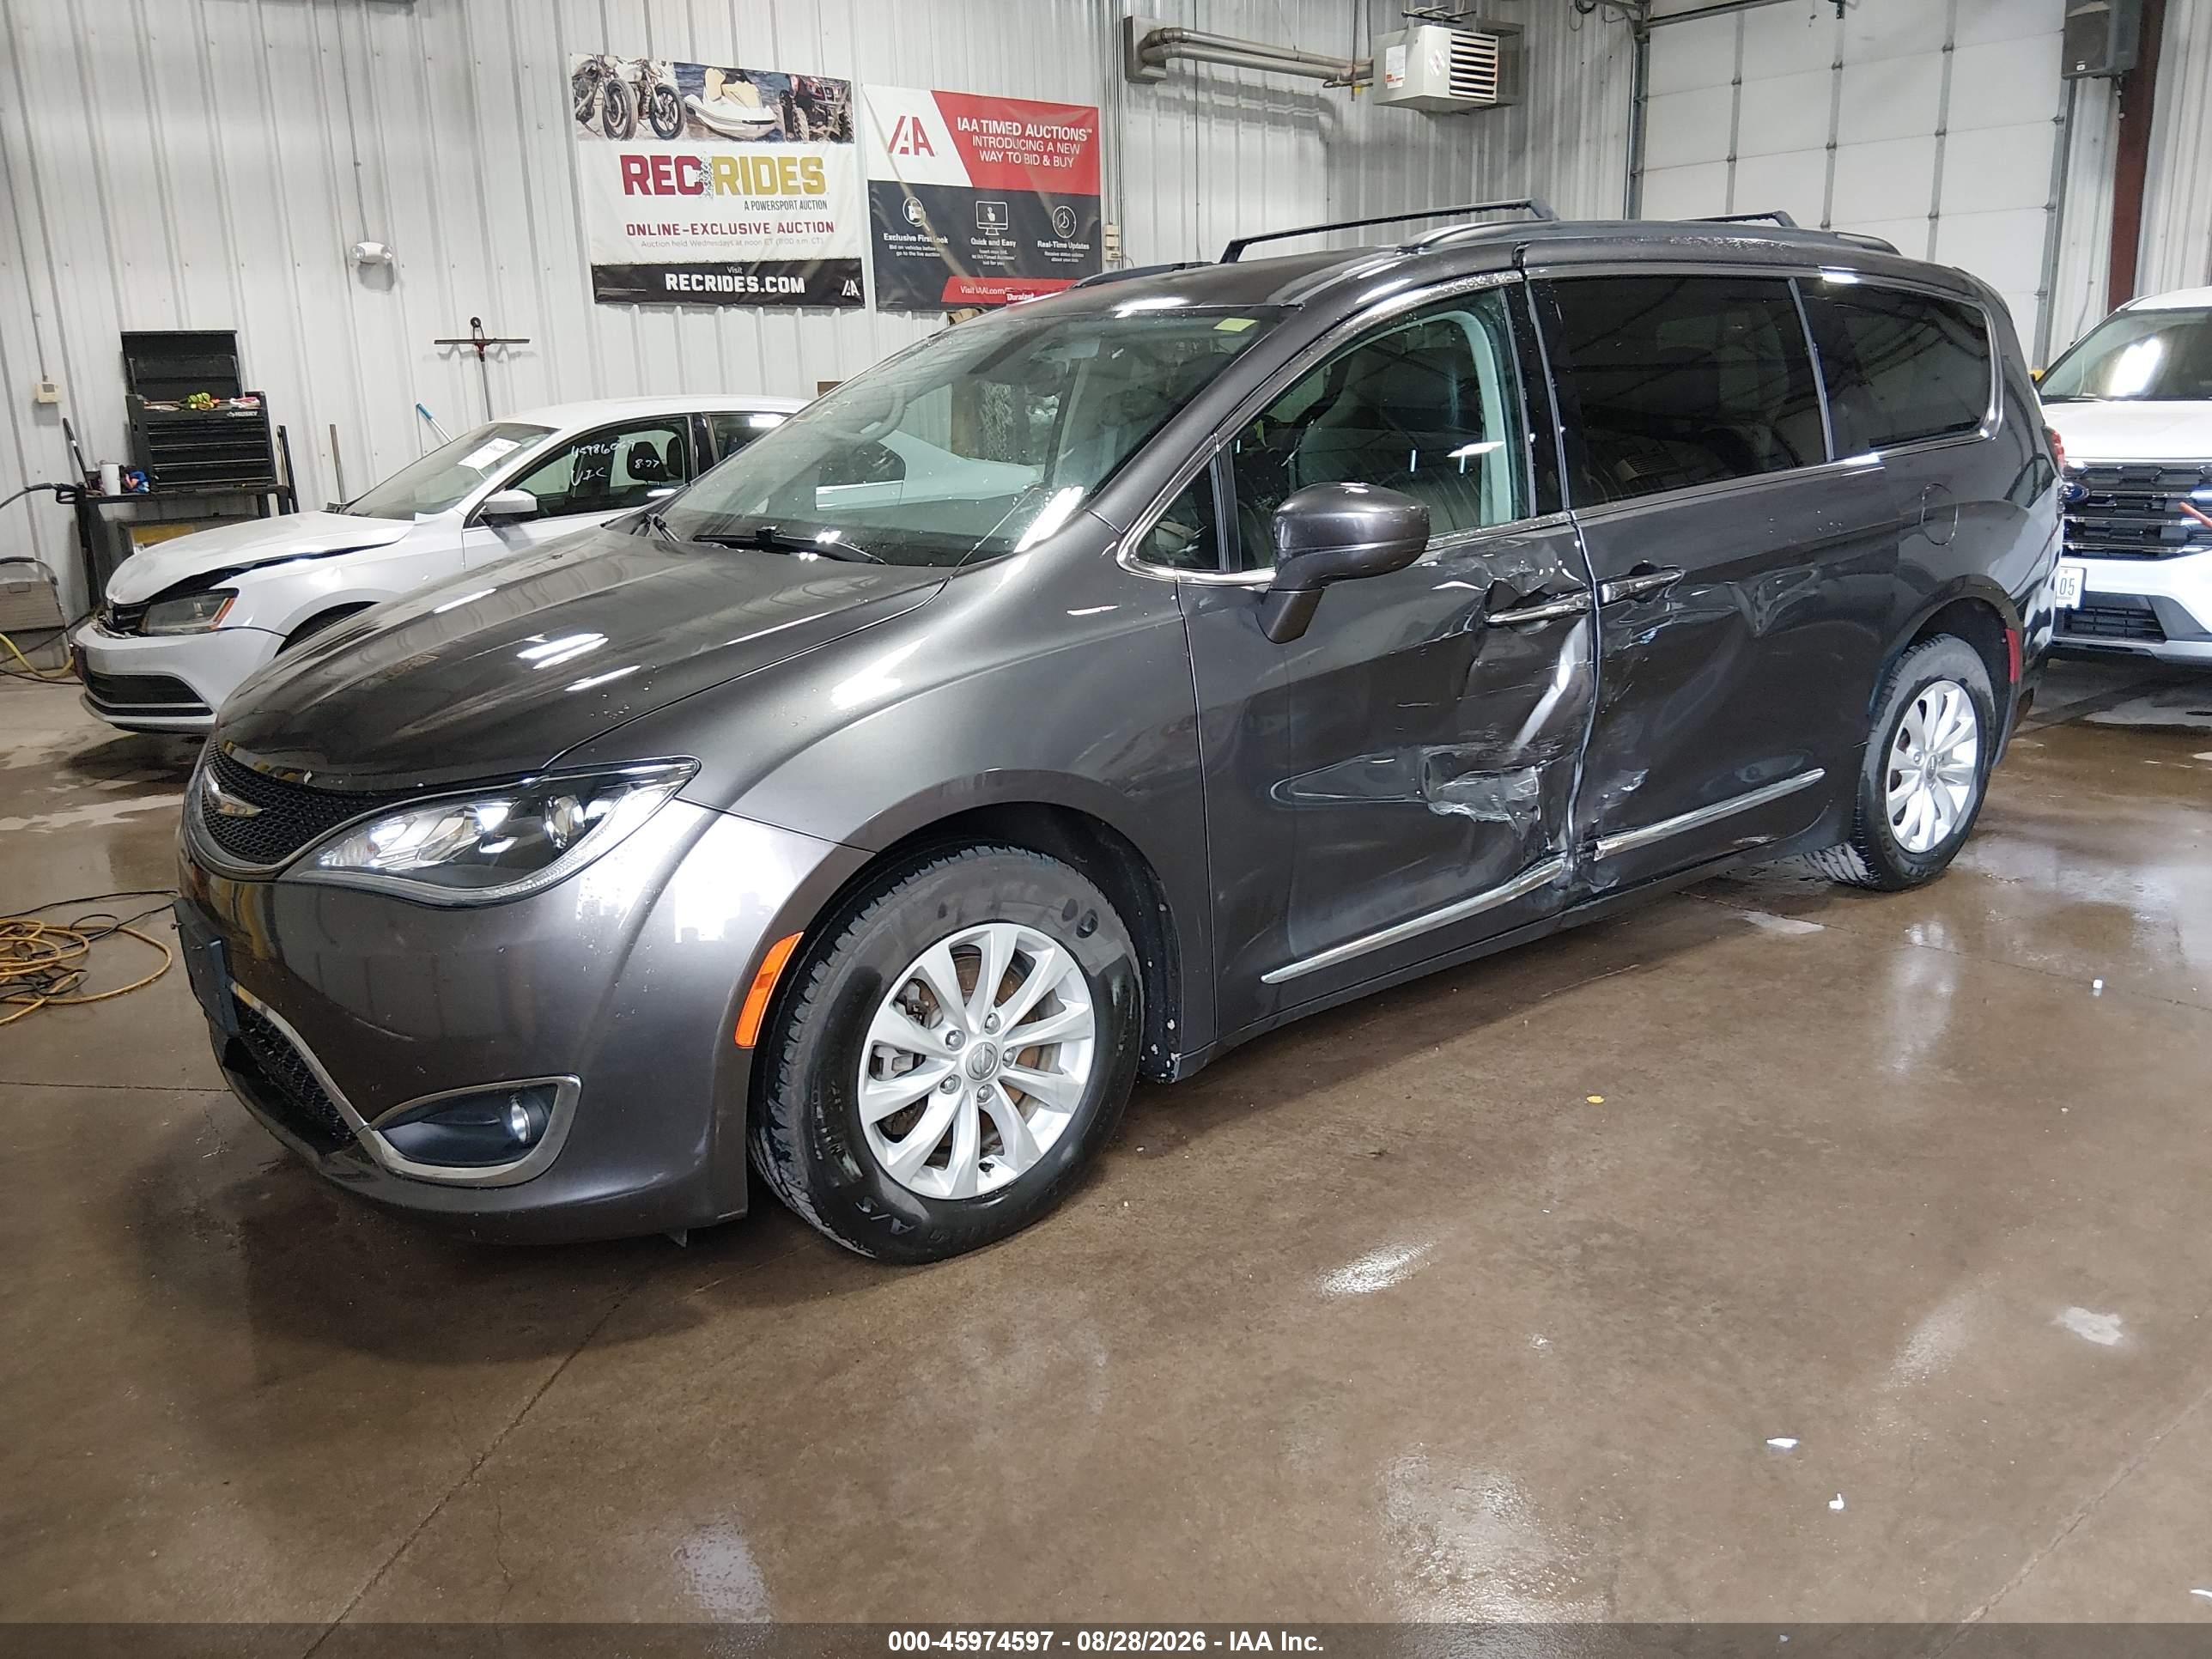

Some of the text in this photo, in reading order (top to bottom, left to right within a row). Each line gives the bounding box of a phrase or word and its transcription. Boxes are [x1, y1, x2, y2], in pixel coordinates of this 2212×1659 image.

[957, 116, 978, 132] IAA
[981, 119, 1022, 137] TIMED
[972, 135, 1080, 155] INTRODUCING A NEW
[979, 150, 1074, 168] WAY TO BID & BUY
[619, 155, 827, 196] REC RIDES
[744, 199, 828, 211] A POWERSPORT AUCTION
[626, 222, 835, 236] ONLINE-EXCLUSIVE AUCTION
[883, 233, 916, 242] Exclusive
[970, 237, 987, 246] Quick
[1001, 240, 1017, 248] Easy
[641, 240, 671, 248] Auction
[1036, 240, 1090, 250] Real-Time Updates
[726, 265, 743, 274] Visit
[665, 273, 805, 294] RECRIDES.COM
[960, 285, 975, 295] Visit
